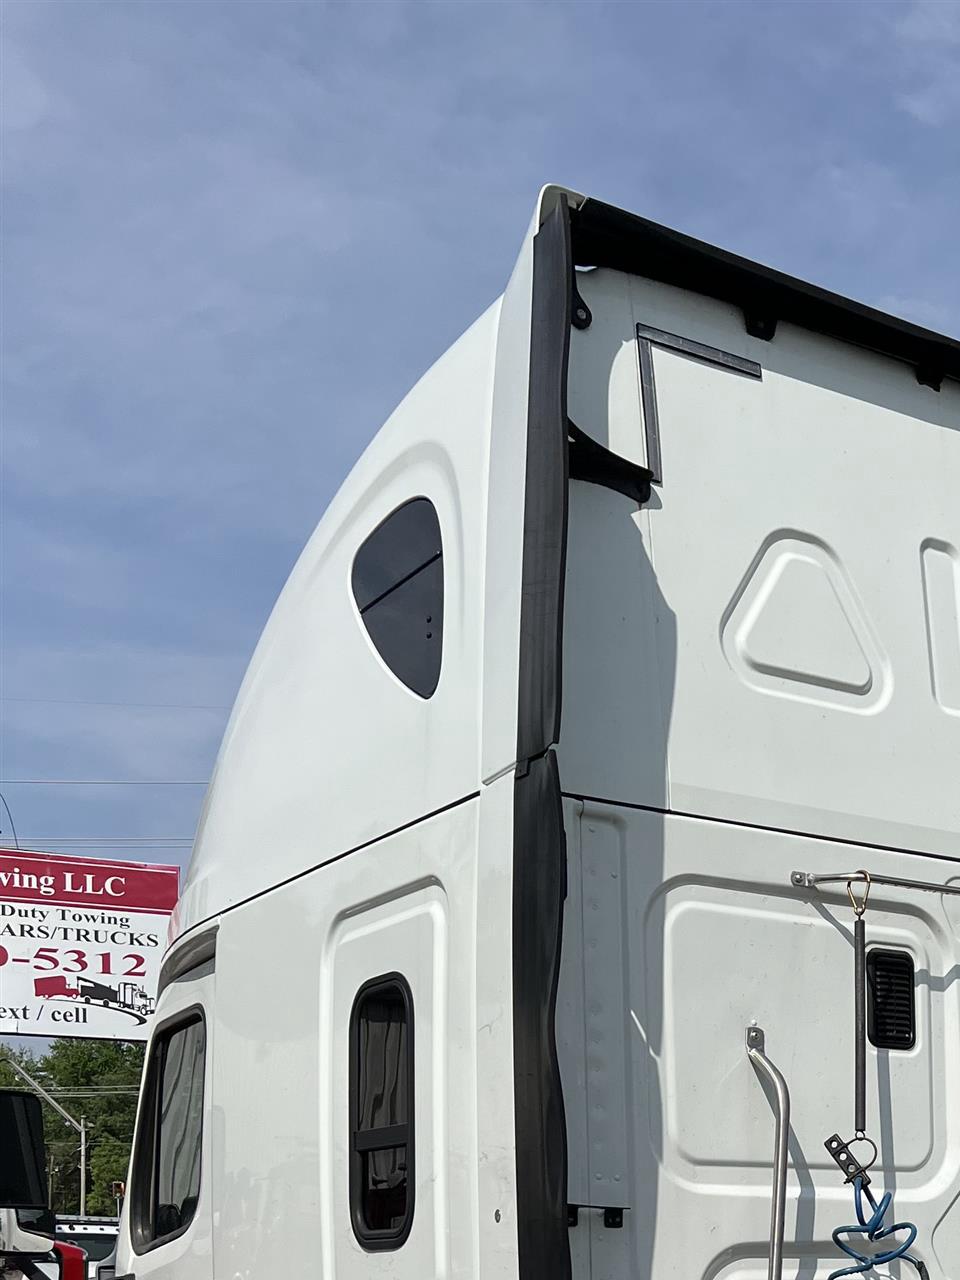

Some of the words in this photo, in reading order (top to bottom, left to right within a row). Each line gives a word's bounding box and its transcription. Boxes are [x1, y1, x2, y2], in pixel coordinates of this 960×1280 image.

[63, 872, 126, 897] LLC
[1, 904, 50, 922] Duty
[56, 908, 131, 928] Towing
[51, 1007, 88, 1024] cell
